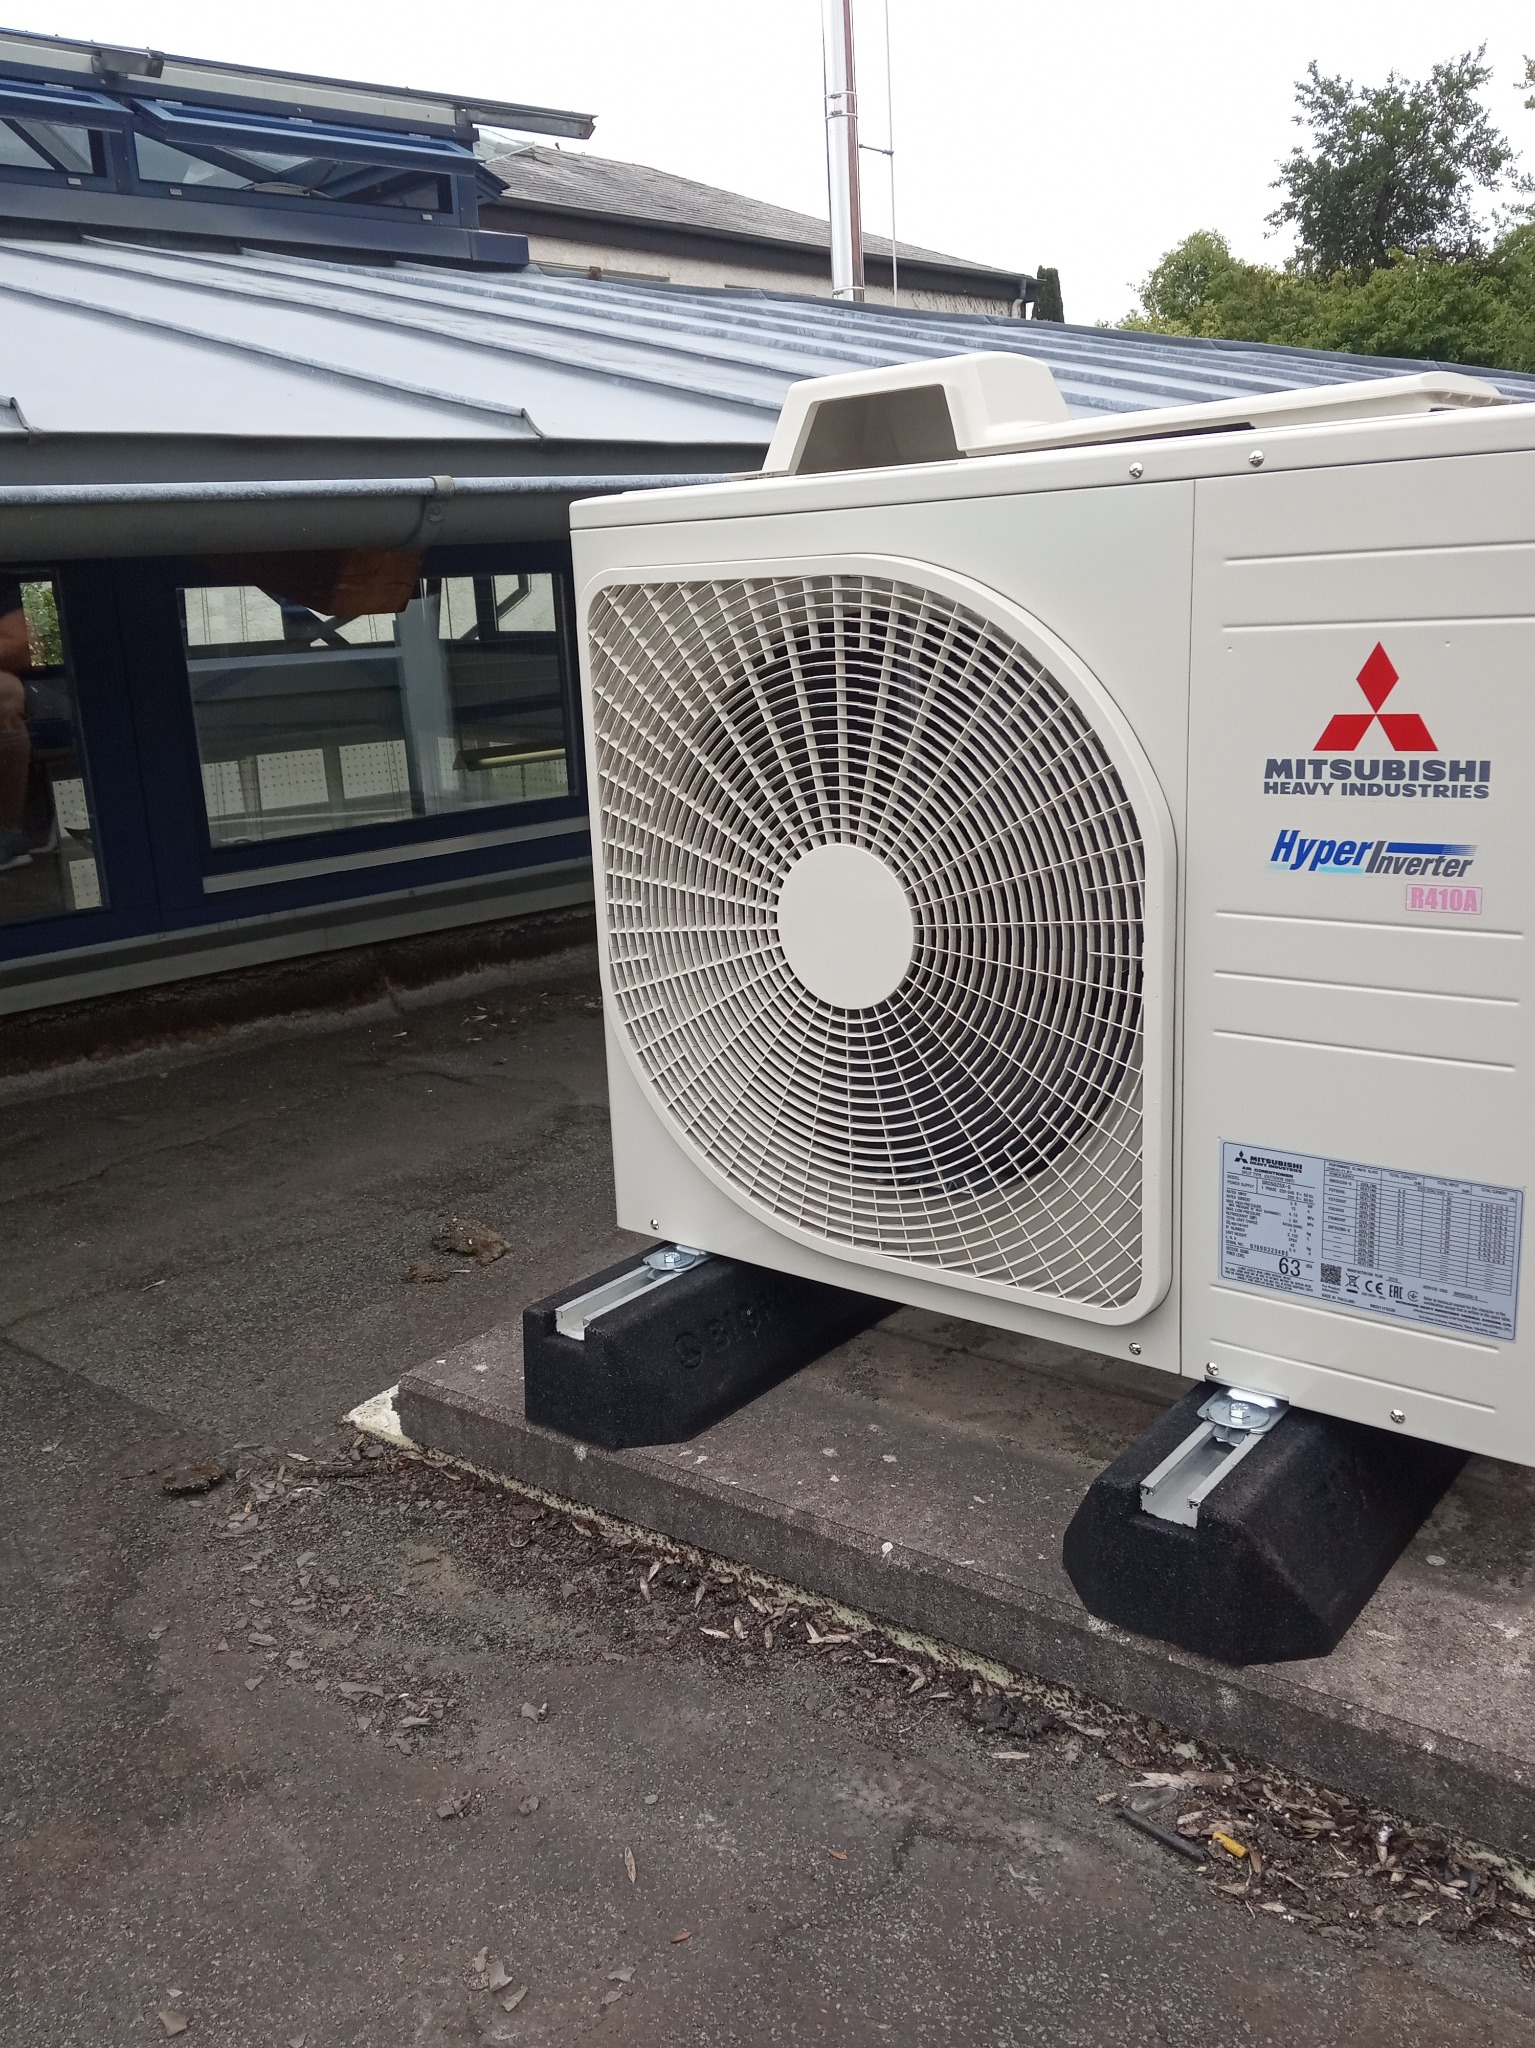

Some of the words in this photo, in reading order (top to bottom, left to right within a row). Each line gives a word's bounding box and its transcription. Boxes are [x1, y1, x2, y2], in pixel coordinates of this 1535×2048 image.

[1264, 758, 1491, 783] MITSUBISHI
[1263, 781, 1334, 795] HEAVY
[1341, 782, 1489, 799] INDUSTRIES
[1270, 829, 1374, 871] Hyper
[1365, 840, 1474, 878] Inverter
[1410, 886, 1478, 912] R410A
[1250, 1156, 1302, 1170] MITSUBISHI
[1279, 1257, 1301, 1277] 63
[1365, 1280, 1383, 1295] CE
[1389, 1284, 1404, 1299] EAC
